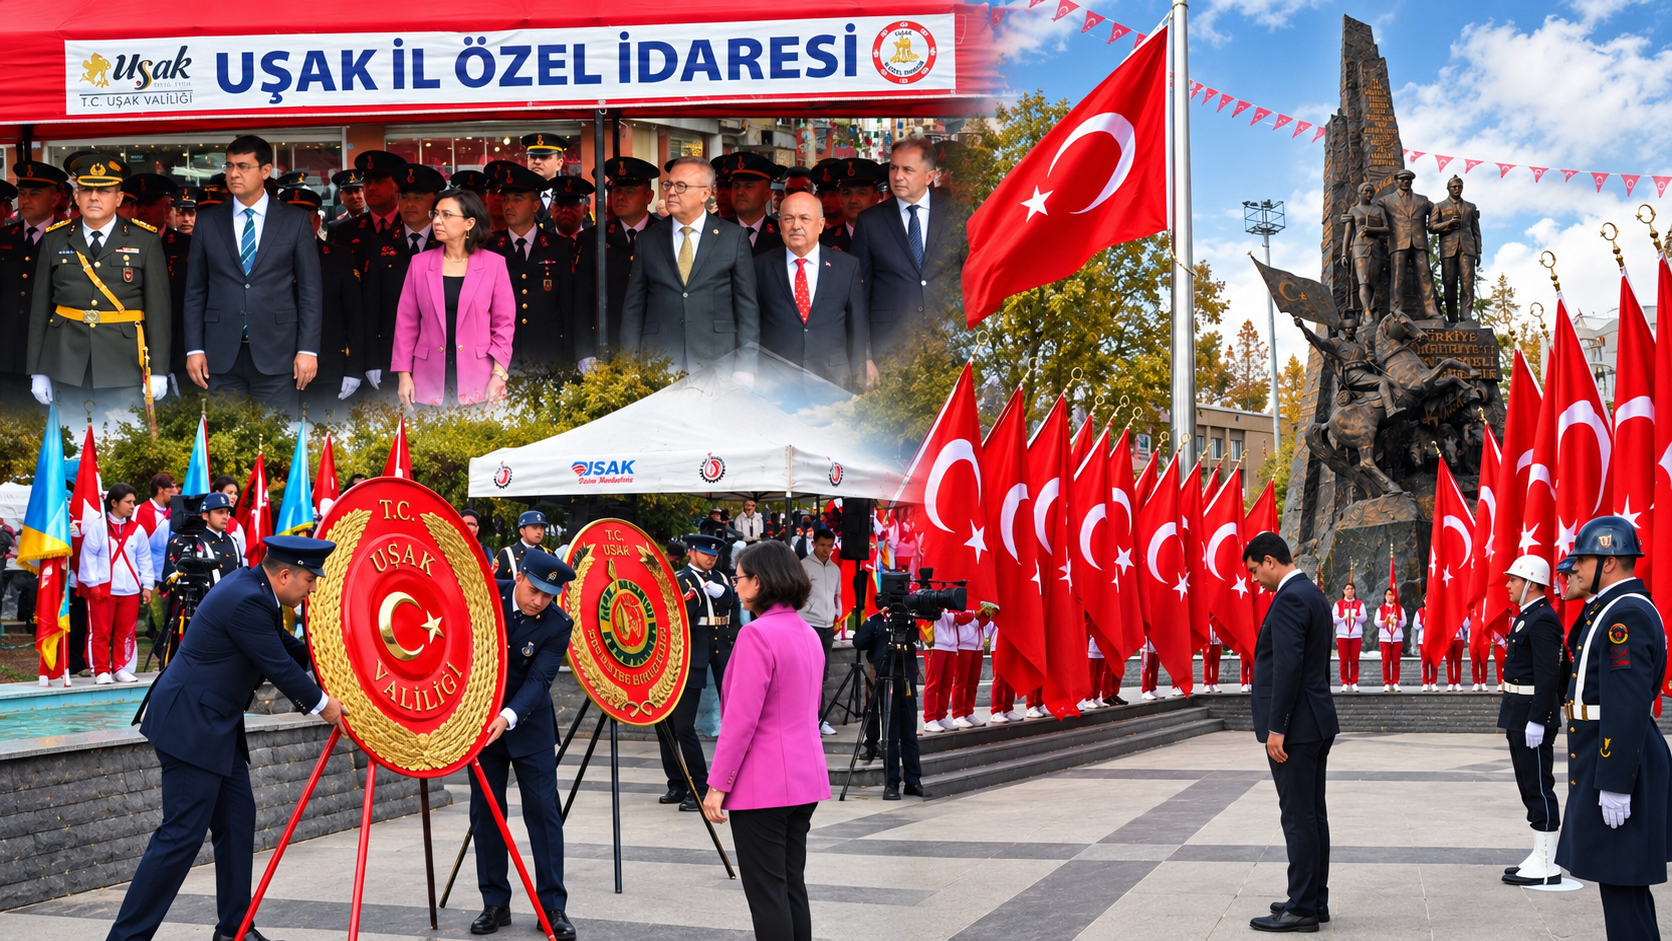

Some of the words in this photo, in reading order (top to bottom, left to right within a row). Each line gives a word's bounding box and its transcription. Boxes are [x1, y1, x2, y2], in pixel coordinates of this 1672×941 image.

[112, 45, 192, 90] Uşak
[216, 50, 379, 105] UŞAK
[392, 37, 441, 90] İL
[454, 36, 602, 88] ÖZEL
[618, 23, 857, 84] İDARESİ
[80, 97, 103, 107] T.C.
[106, 95, 141, 109] UŞAK
[379, 499, 415, 522] T.C.
[605, 529, 625, 542] T.C.
[369, 541, 436, 577] UŞAK
[374, 659, 463, 713] VALİLİĞİ
